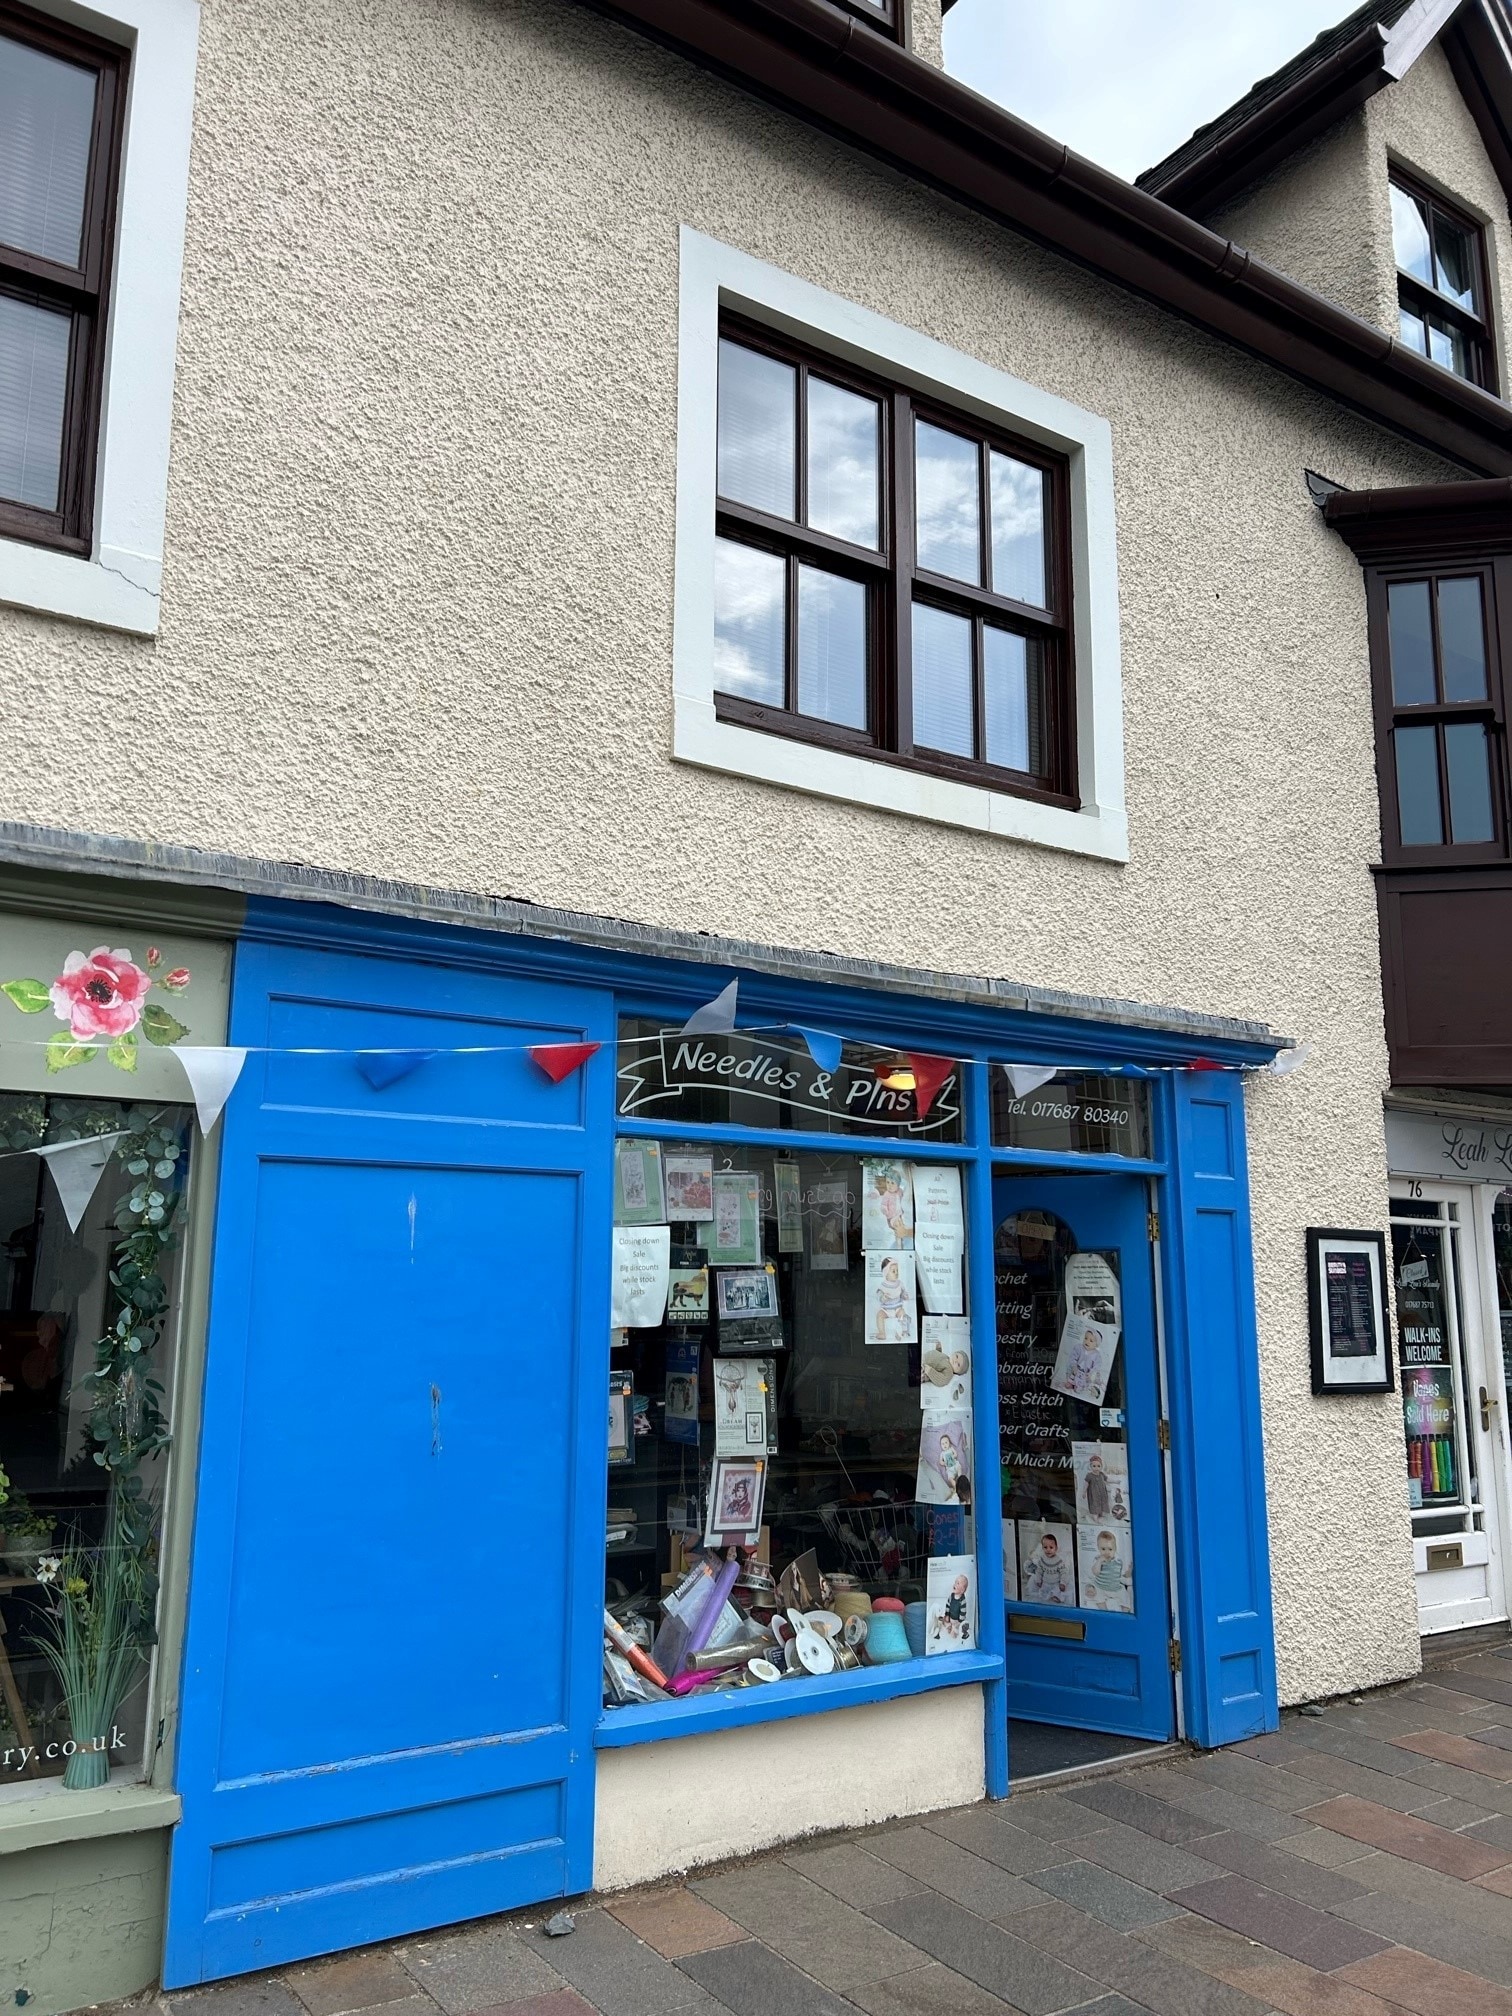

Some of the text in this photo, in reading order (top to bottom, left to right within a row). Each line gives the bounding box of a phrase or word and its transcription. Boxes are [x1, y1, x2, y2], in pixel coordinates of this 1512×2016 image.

[672, 1042, 801, 1090] Needles
[809, 1072, 834, 1100] &
[1008, 1099, 1129, 1125] Tel. 017687 80340
[1442, 1122, 1512, 1174] Leah L
[1408, 1181, 1423, 1198] 76
[833, 1191, 856, 1211] go
[922, 1232, 954, 1240] Closing down
[1022, 1224, 1049, 1238] OPEN
[619, 1237, 641, 1246] Closing
[932, 1256, 954, 1264] discounts
[620, 1264, 628, 1273] Big
[995, 1300, 1033, 1319] itting
[1404, 1327, 1441, 1343] WALK-INS
[1405, 1345, 1442, 1361] WELCOME
[767, 1360, 776, 1412] DIMENSIONS
[1413, 1379, 1440, 1400] Vapes
[1021, 1391, 1064, 1407] Stitch
[1406, 1405, 1450, 1424] Sold Here
[1025, 1422, 1070, 1438] Crafts
[1014, 1453, 1054, 1468] Much
[2, 1725, 127, 1771] ry.co.uk
